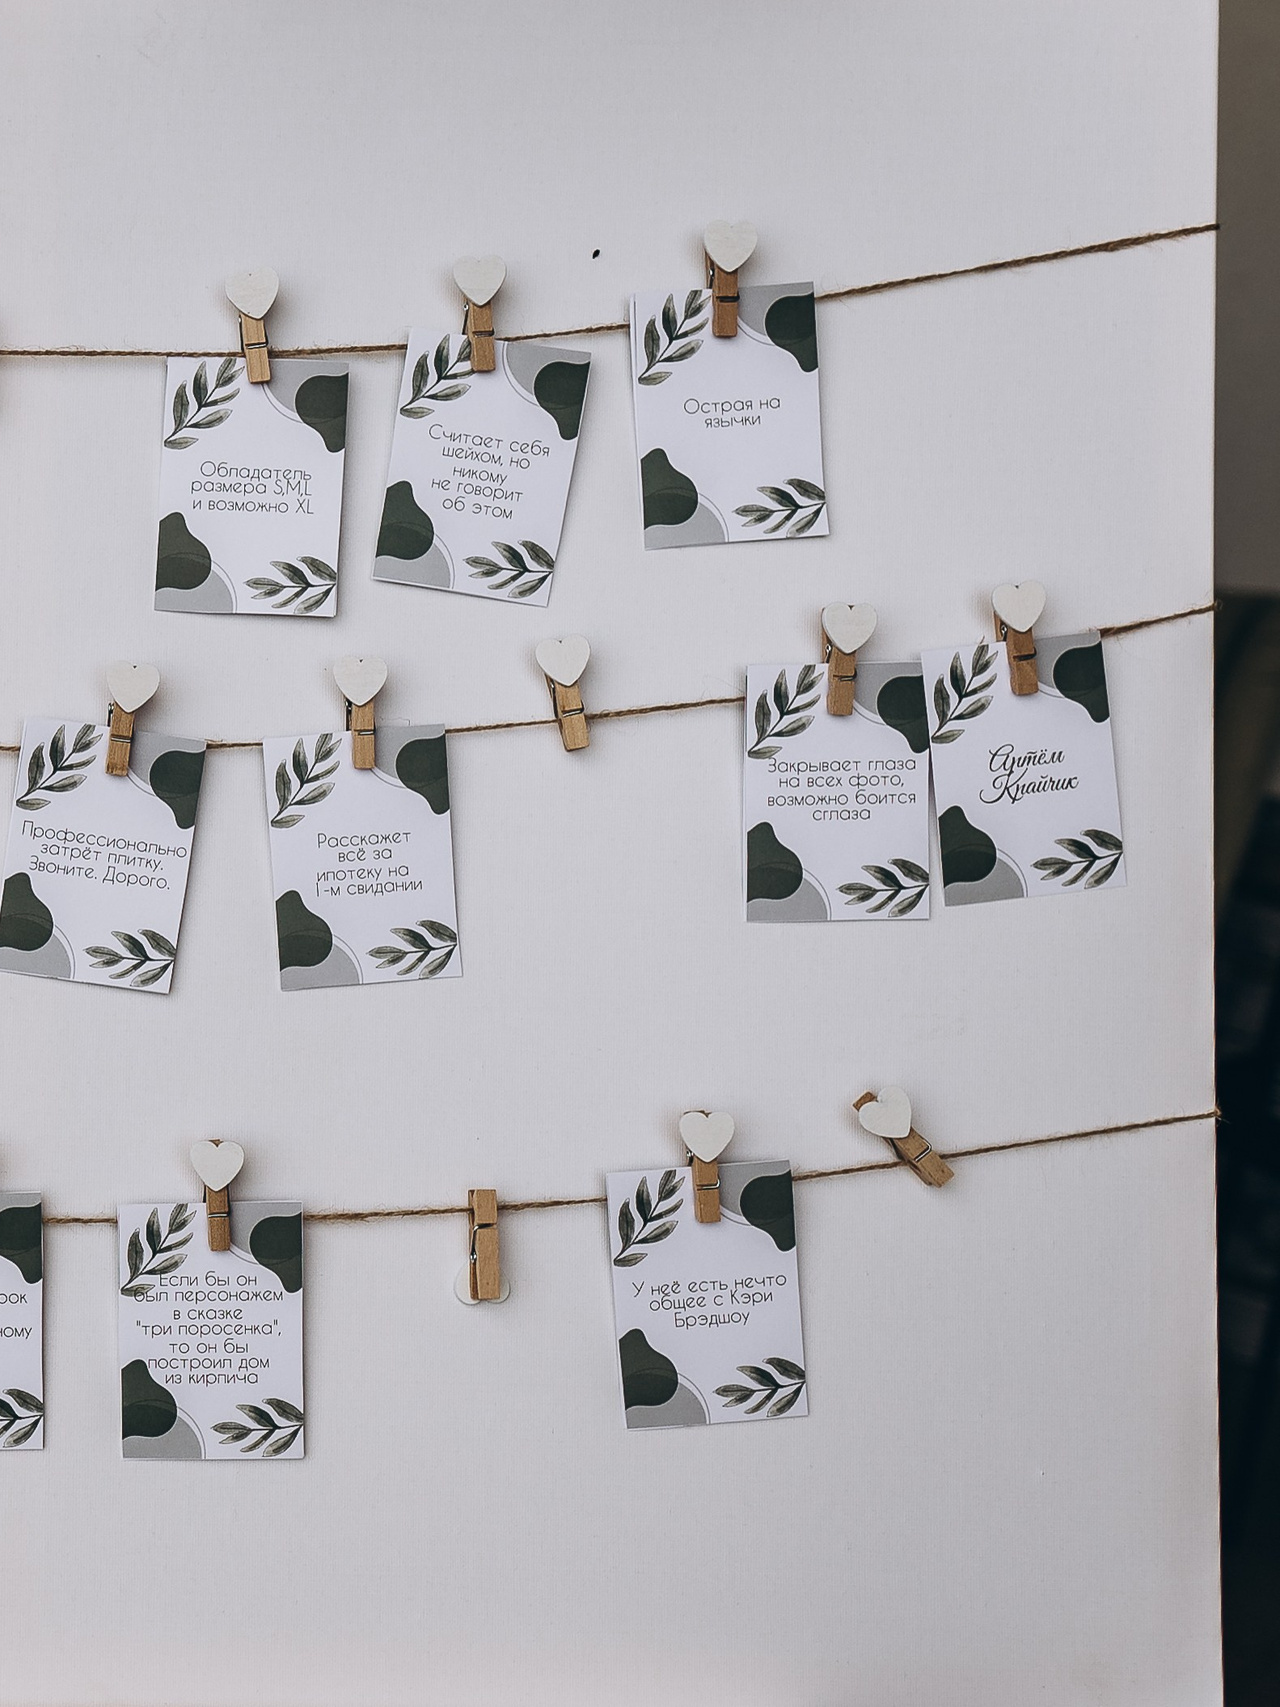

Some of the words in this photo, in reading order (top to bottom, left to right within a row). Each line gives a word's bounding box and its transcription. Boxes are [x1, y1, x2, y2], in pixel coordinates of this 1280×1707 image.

[684, 398, 753, 415] Острая
[760, 398, 780, 409] на
[705, 415, 761, 428] язычки
[429, 424, 503, 450] Считает
[510, 436, 550, 457] себя
[442, 446, 503, 467] шейхом,
[509, 457, 530, 469] но
[200, 461, 313, 482] Обладатель
[453, 466, 507, 487] никому
[191, 479, 266, 497] размера
[431, 479, 451, 491] не
[457, 482, 523, 502] говорит
[193, 499, 201, 510] и
[208, 500, 289, 513] возможно
[296, 498, 314, 514] XL
[442, 496, 465, 511] об
[472, 503, 512, 519] этом
[767, 757, 861, 776] Закрывает
[868, 759, 916, 771] глаза
[988, 744, 1065, 773] Артём
[779, 776, 800, 788] на
[807, 776, 843, 788] всех
[849, 772, 904, 789] фото,
[979, 766, 1080, 804] Крайчик
[768, 794, 850, 806] возможно
[856, 789, 916, 804] боится
[813, 808, 870, 821] сглаза
[22, 820, 187, 857] Профессионально
[318, 832, 411, 850] Расскажет
[41, 840, 101, 861] затрёт
[108, 853, 163, 871] плитку.
[338, 847, 366, 862] всё
[373, 848, 392, 862] за
[29, 855, 97, 879] Звоните.
[102, 866, 169, 890] Дорого.
[317, 867, 382, 883] ипотеку
[387, 866, 409, 879] на
[346, 877, 422, 896] свидании
[160, 1273, 198, 1286] Если
[205, 1271, 231, 1286] бы
[236, 1275, 257, 1286] он
[632, 1281, 644, 1297] У
[650, 1281, 681, 1296] неё
[688, 1281, 728, 1292] есть
[733, 1275, 787, 1289] нечто
[134, 1288, 169, 1302] был
[174, 1288, 283, 1305] персонажем
[650, 1292, 706, 1311] общее
[713, 1295, 723, 1306] с
[730, 1289, 773, 1307] Кэри
[173, 1309, 180, 1319] в
[187, 1309, 243, 1320] сказке
[674, 1309, 750, 1330] Брэдшоу
[136, 1320, 172, 1339] "три
[177, 1319, 282, 1339] поросенка",
[169, 1340, 190, 1354] то
[196, 1343, 217, 1354] он
[224, 1337, 248, 1353] бы
[147, 1357, 232, 1370] построил
[238, 1357, 269, 1372] дом
[165, 1373, 183, 1385] из
[188, 1373, 258, 1387] кирпича
